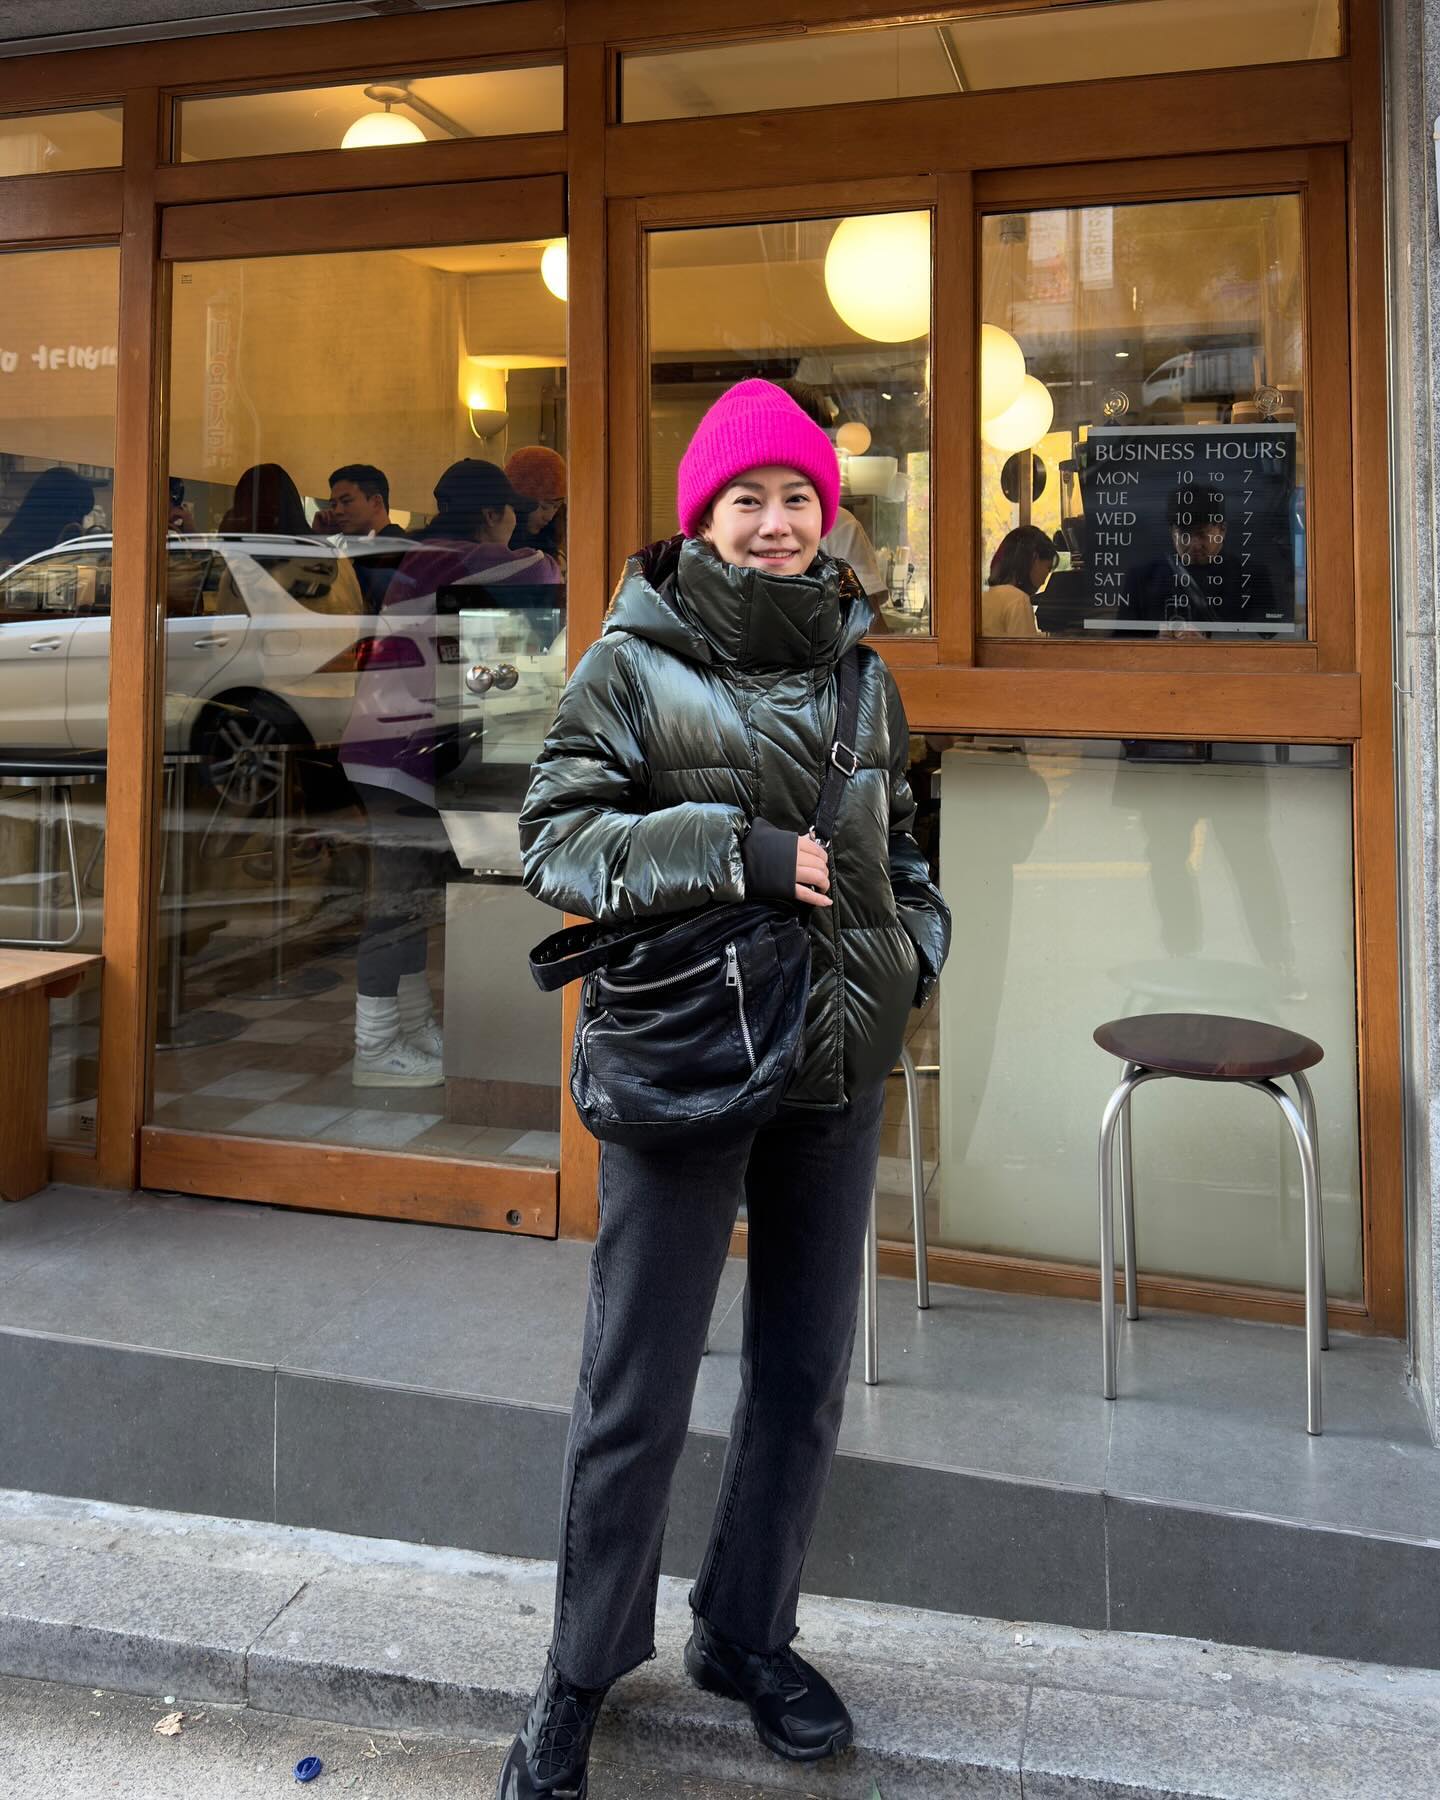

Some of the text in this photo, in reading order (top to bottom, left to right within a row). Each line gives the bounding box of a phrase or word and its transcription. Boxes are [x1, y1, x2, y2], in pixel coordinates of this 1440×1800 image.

[1095, 441, 1287, 461] BUSINESS HOURS
[1096, 470, 1253, 485] MON 10 TO 7
[1096, 491, 1253, 506] TUE 10 TO 7
[1096, 511, 1253, 526] WED 10 TO 7
[1095, 532, 1252, 546] THU 10 TO 7
[1094, 553, 1251, 567] FRI 10 TO 7
[1094, 573, 1251, 588] SAT 10 TO 7
[1094, 593, 1251, 609] SUN 10 TO 7
